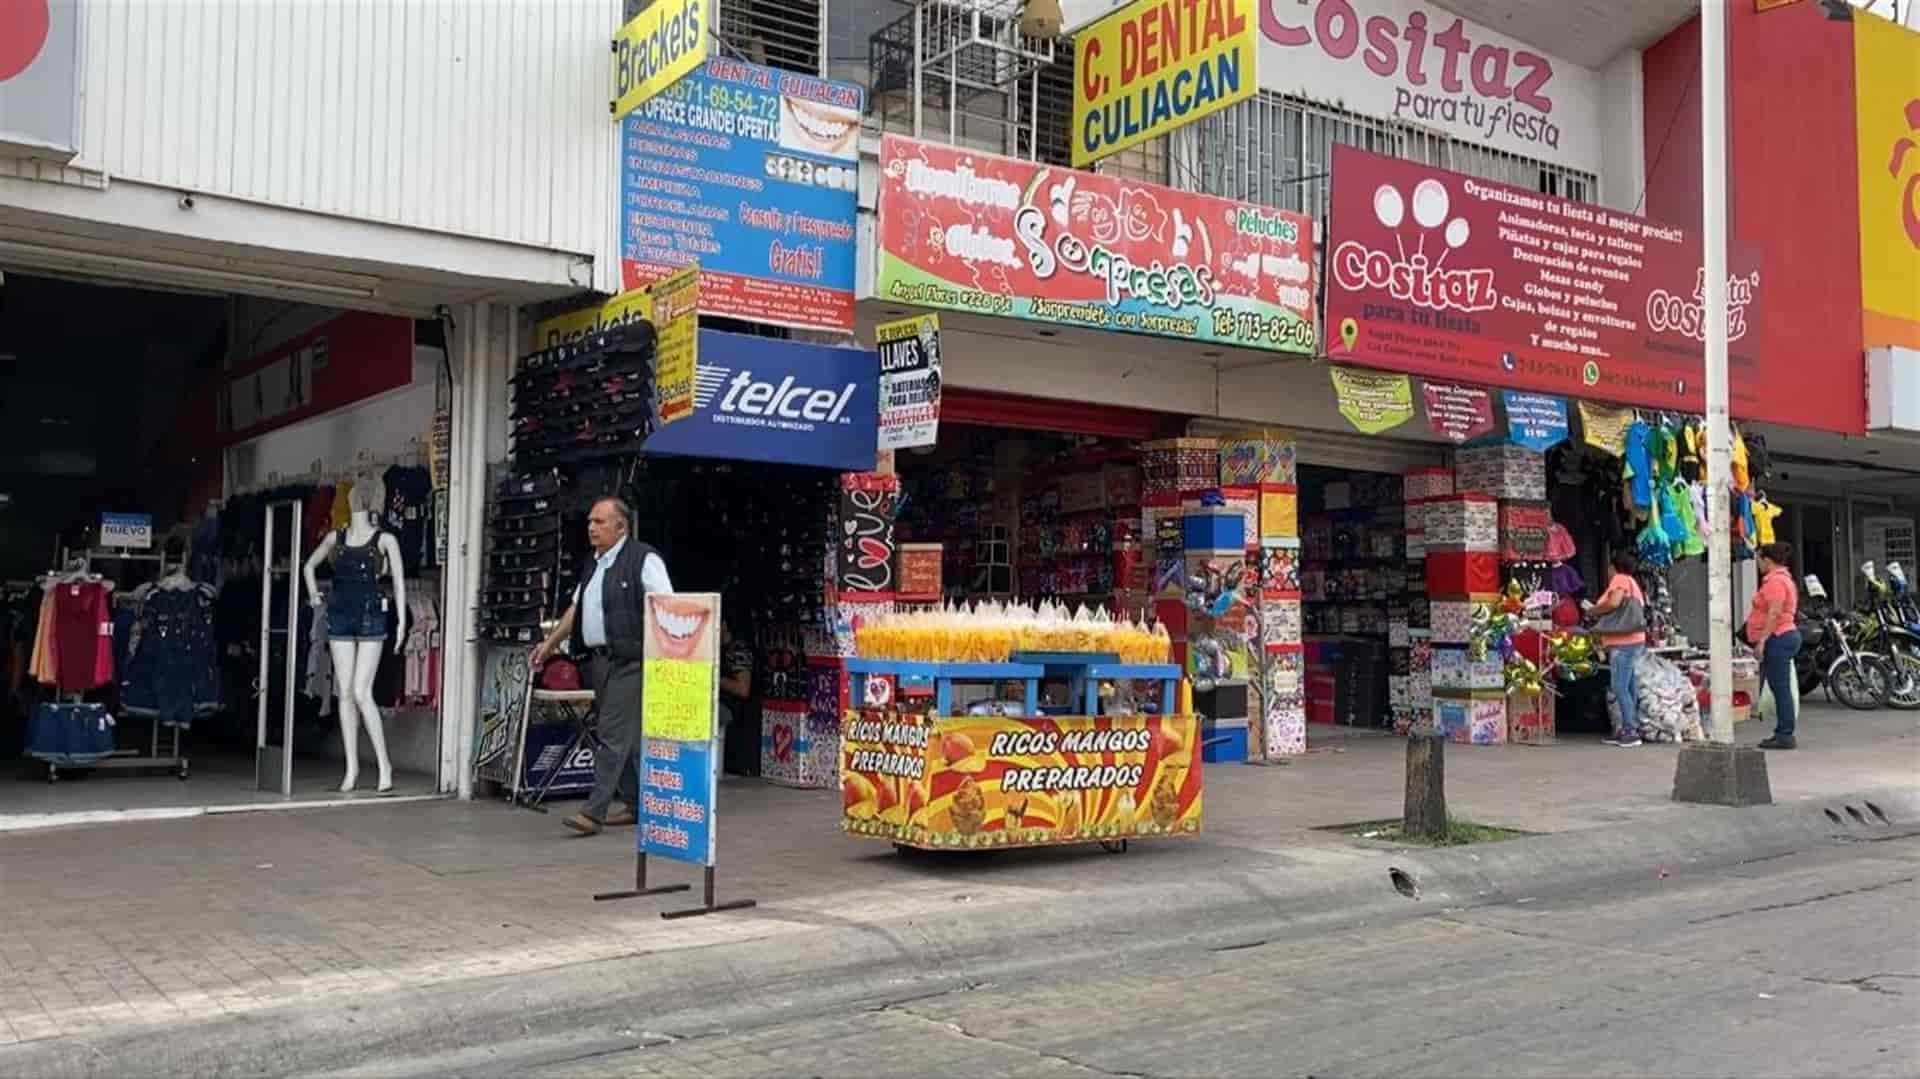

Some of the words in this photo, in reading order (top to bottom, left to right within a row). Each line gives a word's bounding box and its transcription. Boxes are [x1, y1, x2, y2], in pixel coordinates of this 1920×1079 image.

[617, 2, 700, 98] Brackets
[1083, 37, 1109, 101] C.
[1120, 0, 1246, 86] DENTAL
[1258, 0, 1553, 114] Cositaz
[1084, 48, 1239, 152] CULIACAN
[1393, 87, 1456, 122] Para
[1485, 101, 1560, 149] fiesta
[1237, 208, 1297, 244] Peluches
[1464, 180, 1544, 211] Organizamos
[1547, 199, 1561, 215] tu
[1563, 203, 1594, 223] fiesta
[1596, 213, 1608, 226] al
[1609, 217, 1641, 236] mejor
[1333, 241, 1497, 312] Cositaz
[881, 338, 919, 370] LLAVES
[1237, 312, 1313, 346] 713-82-06
[719, 371, 857, 423] telcel
[847, 721, 881, 743] RICOS
[882, 724, 930, 749] MANGOS
[990, 731, 1057, 756] RICOS
[1061, 730, 1150, 753] MANGOS
[851, 750, 925, 780] PREPARADOS
[1001, 765, 1144, 792] PREPARADOS
